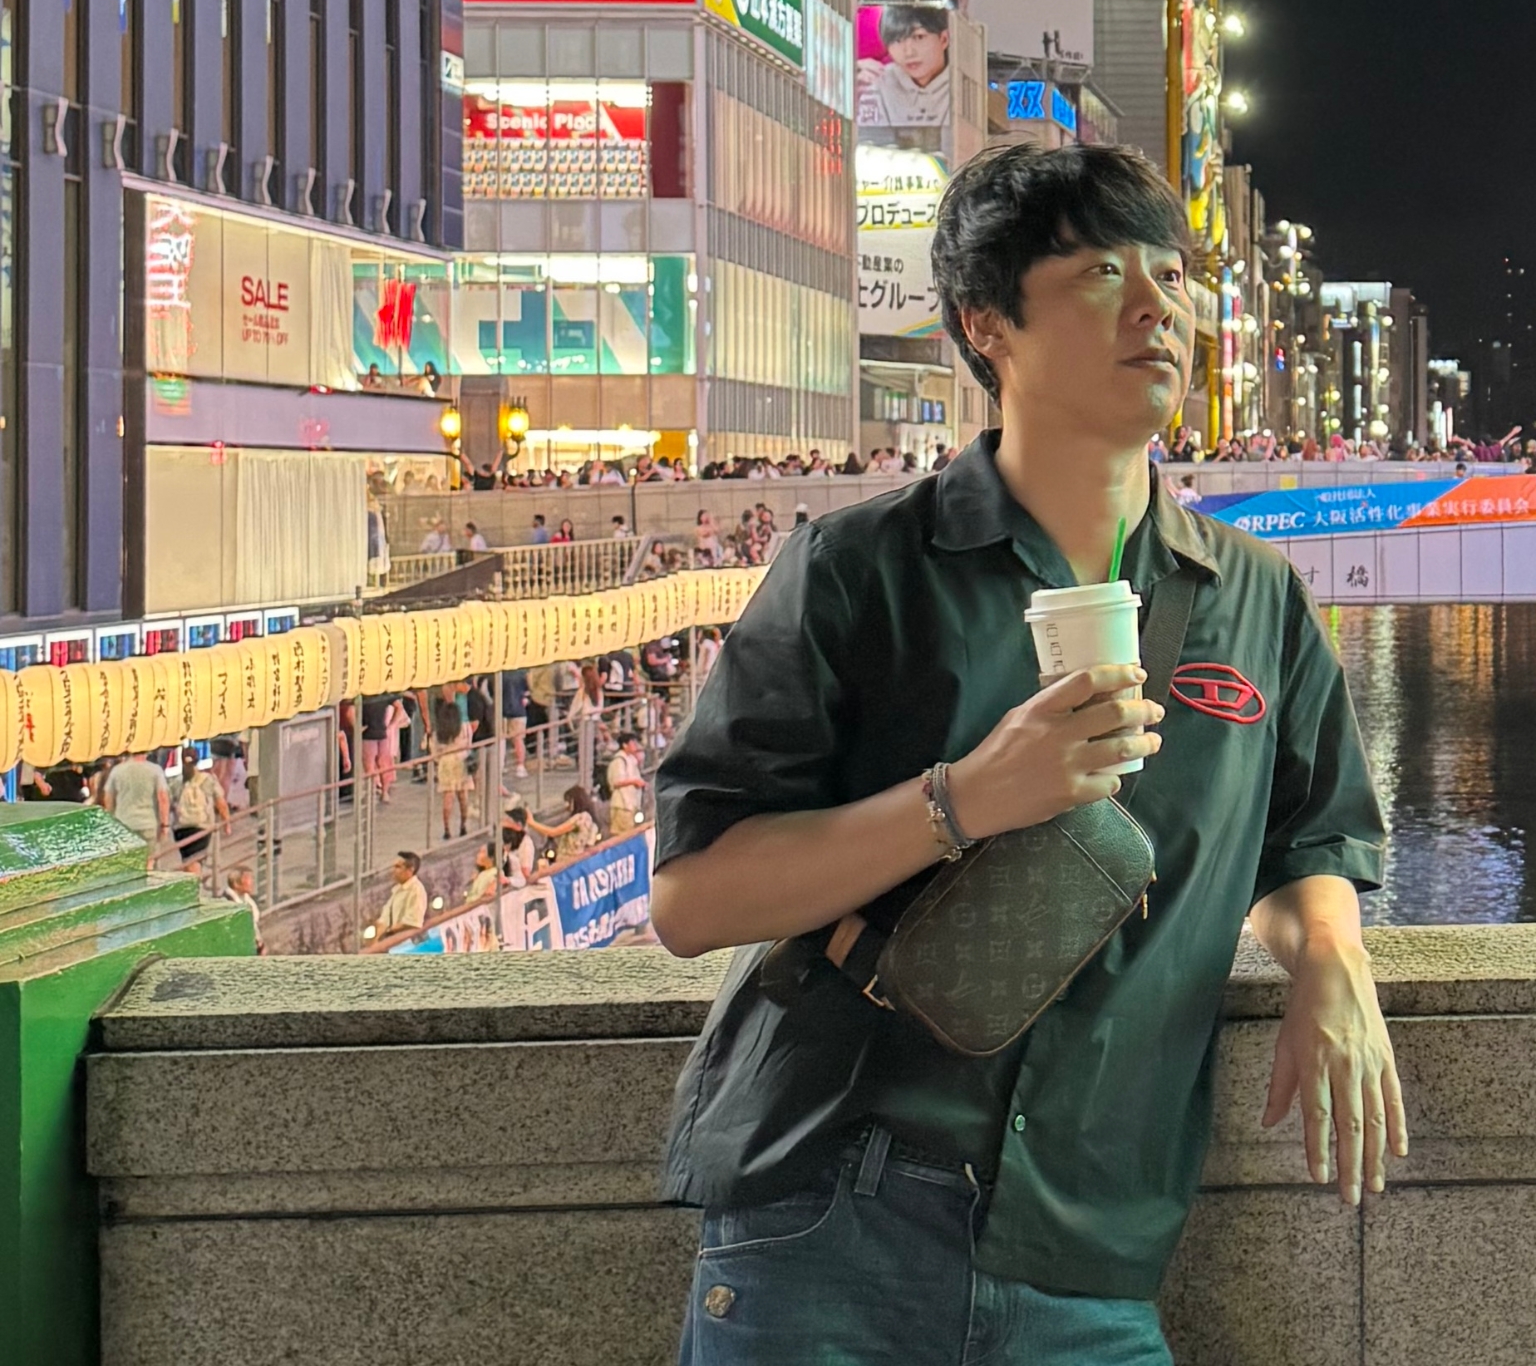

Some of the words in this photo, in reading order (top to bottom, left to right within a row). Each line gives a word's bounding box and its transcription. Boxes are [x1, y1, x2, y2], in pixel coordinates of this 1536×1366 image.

[486, 112, 548, 131] Scenic
[241, 276, 289, 311] SALE
[1314, 488, 1376, 503] 一般社団法人
[1313, 497, 1530, 528] 大阪活性化事業実行委員会
